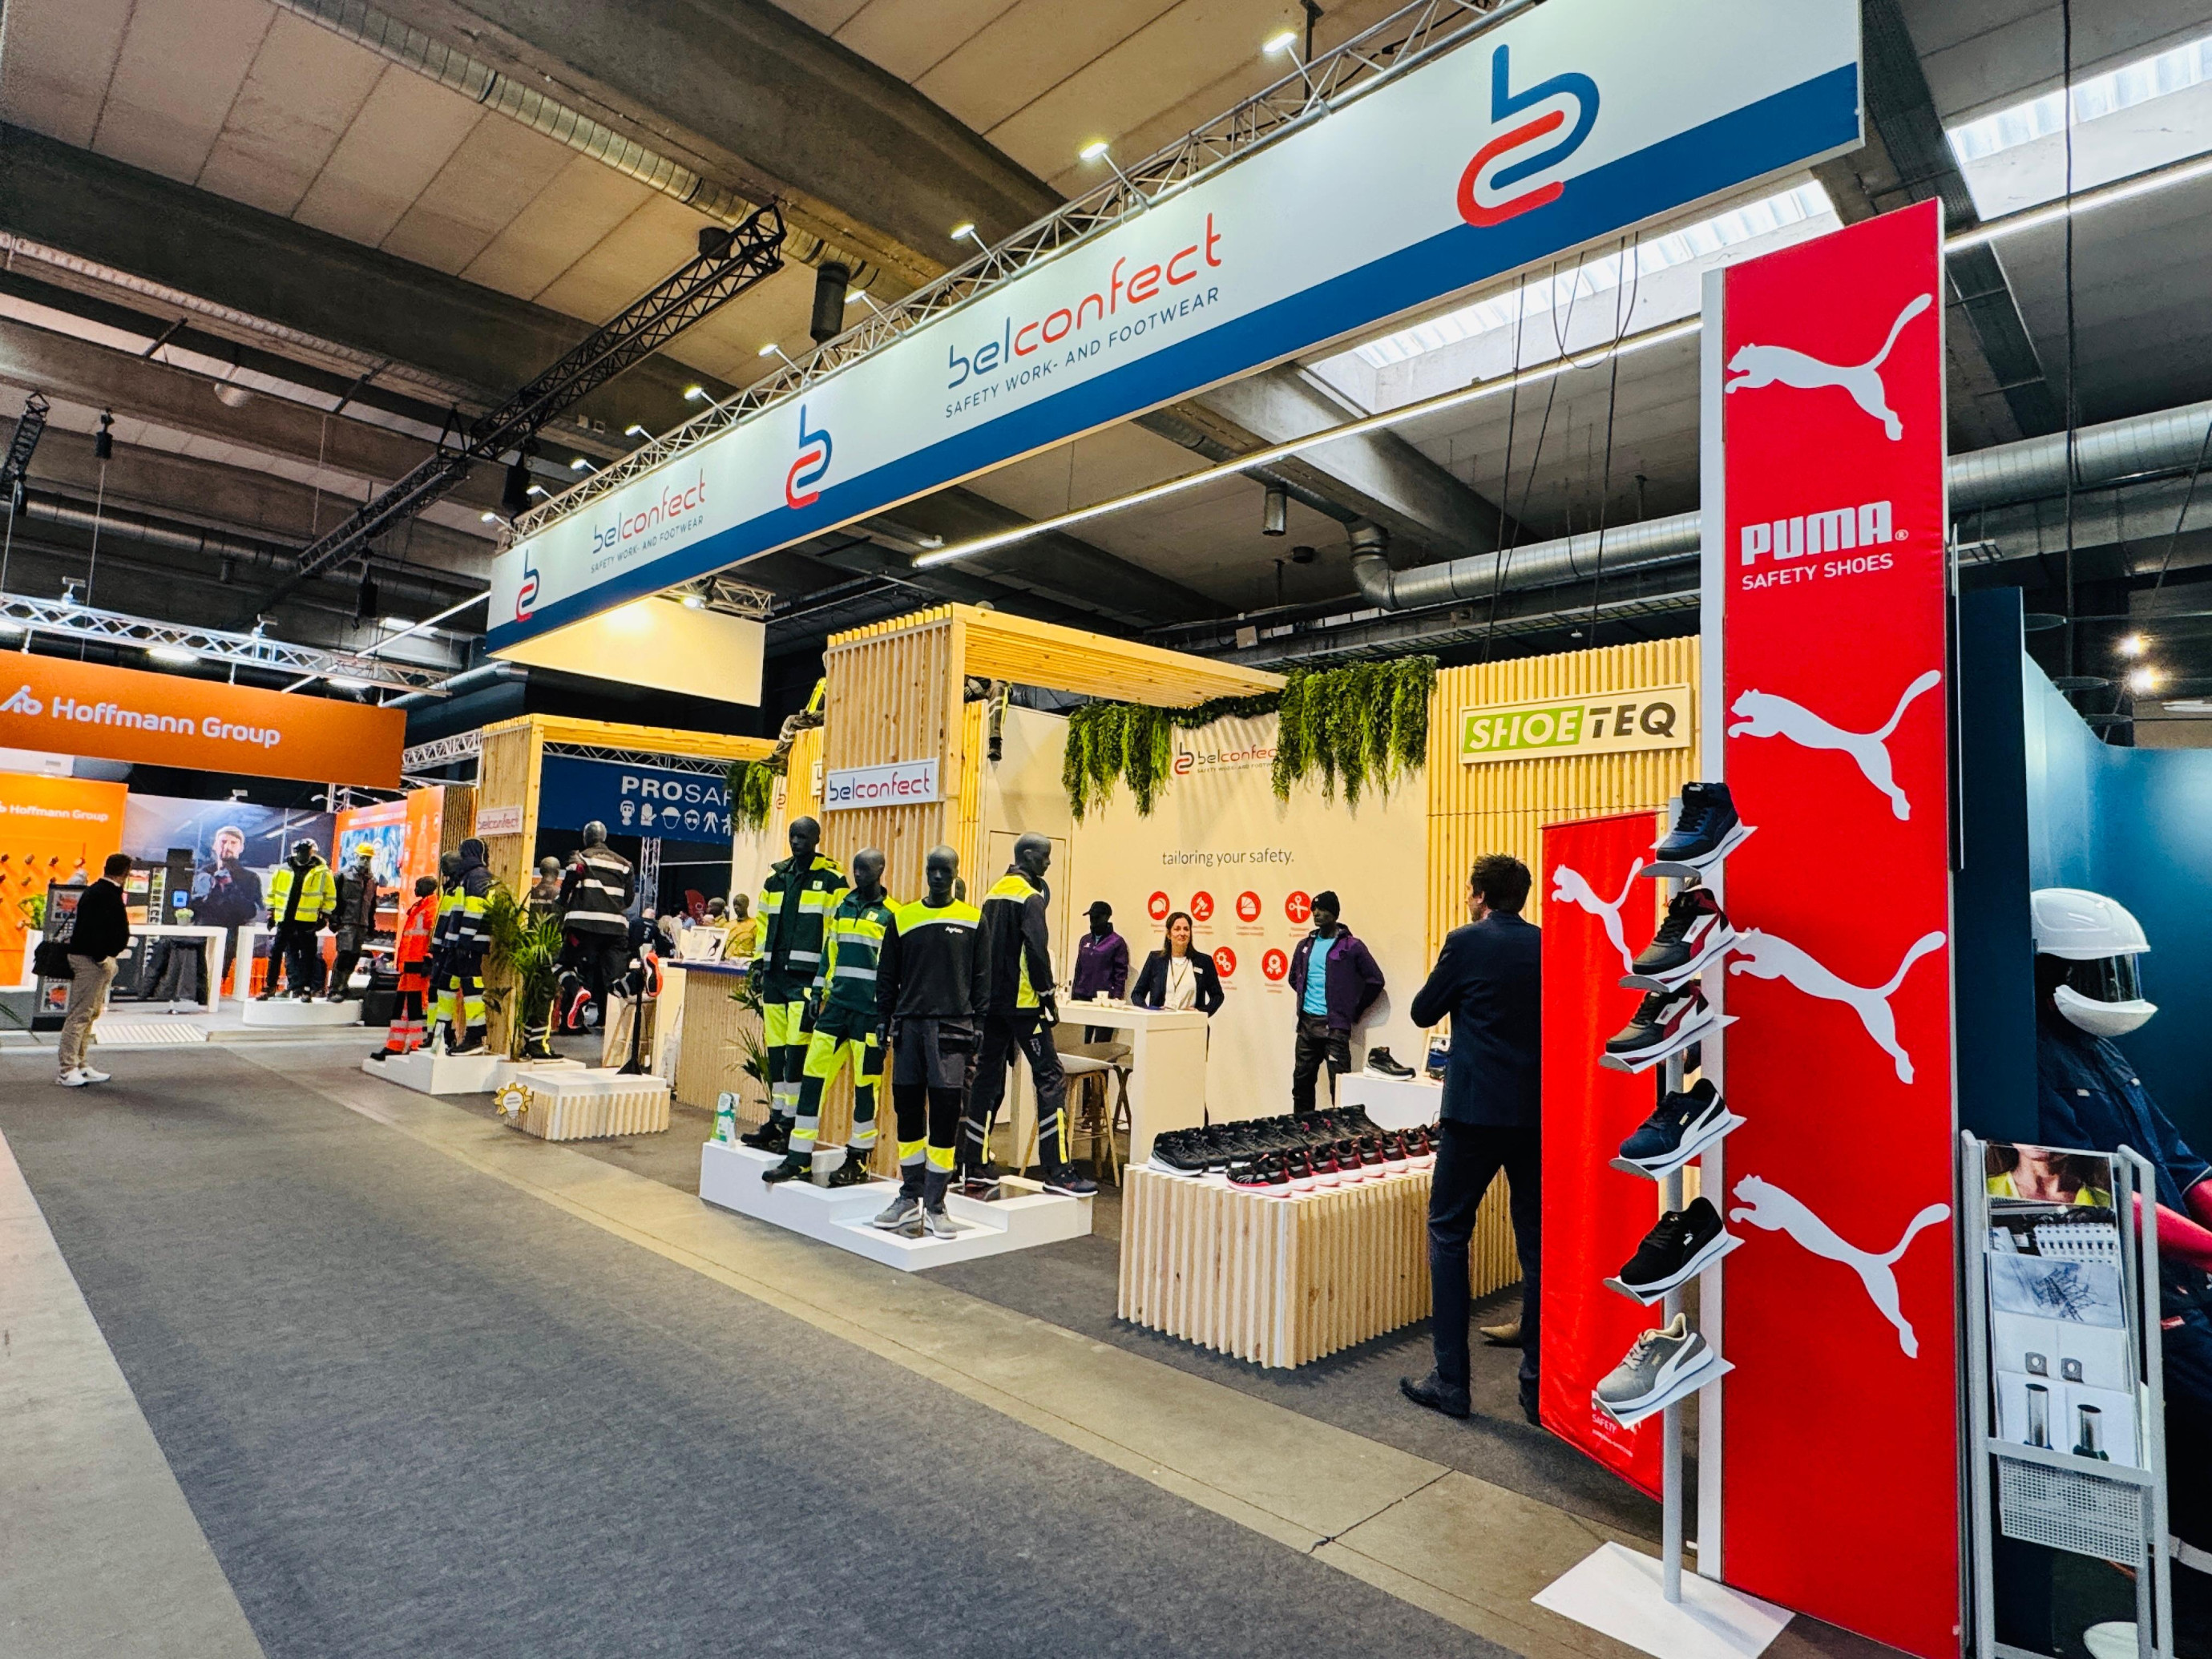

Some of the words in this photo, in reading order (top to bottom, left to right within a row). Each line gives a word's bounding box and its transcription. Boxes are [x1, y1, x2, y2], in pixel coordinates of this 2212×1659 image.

[948, 212, 1221, 390] belconfect
[946, 384, 999, 418] SAFETY
[1005, 359, 1059, 392] WORK-
[1065, 340, 1100, 367] AND
[1108, 287, 1219, 348] FOOTWEAR
[593, 468, 705, 554] belconfect
[591, 557, 615, 574] SAFETY
[617, 545, 640, 562] WORK-
[642, 536, 657, 551] AND
[660, 515, 704, 543] FOOTWEAR
[1742, 564, 1818, 591] SAFETY
[1823, 553, 1894, 578] SHOES
[52, 696, 195, 735] Hoffmann
[202, 716, 281, 749] Group
[1469, 702, 1677, 749] SHOETEQ
[1197, 744, 1278, 765] belconfec
[621, 775, 733, 807] PROSAF
[830, 768, 930, 801] belconfect
[10, 804, 71, 818] Hoffmann
[72, 809, 109, 823] Group
[1162, 850, 1213, 867] tailoring
[1217, 850, 1247, 867] your
[1249, 847, 1294, 866] safety.
